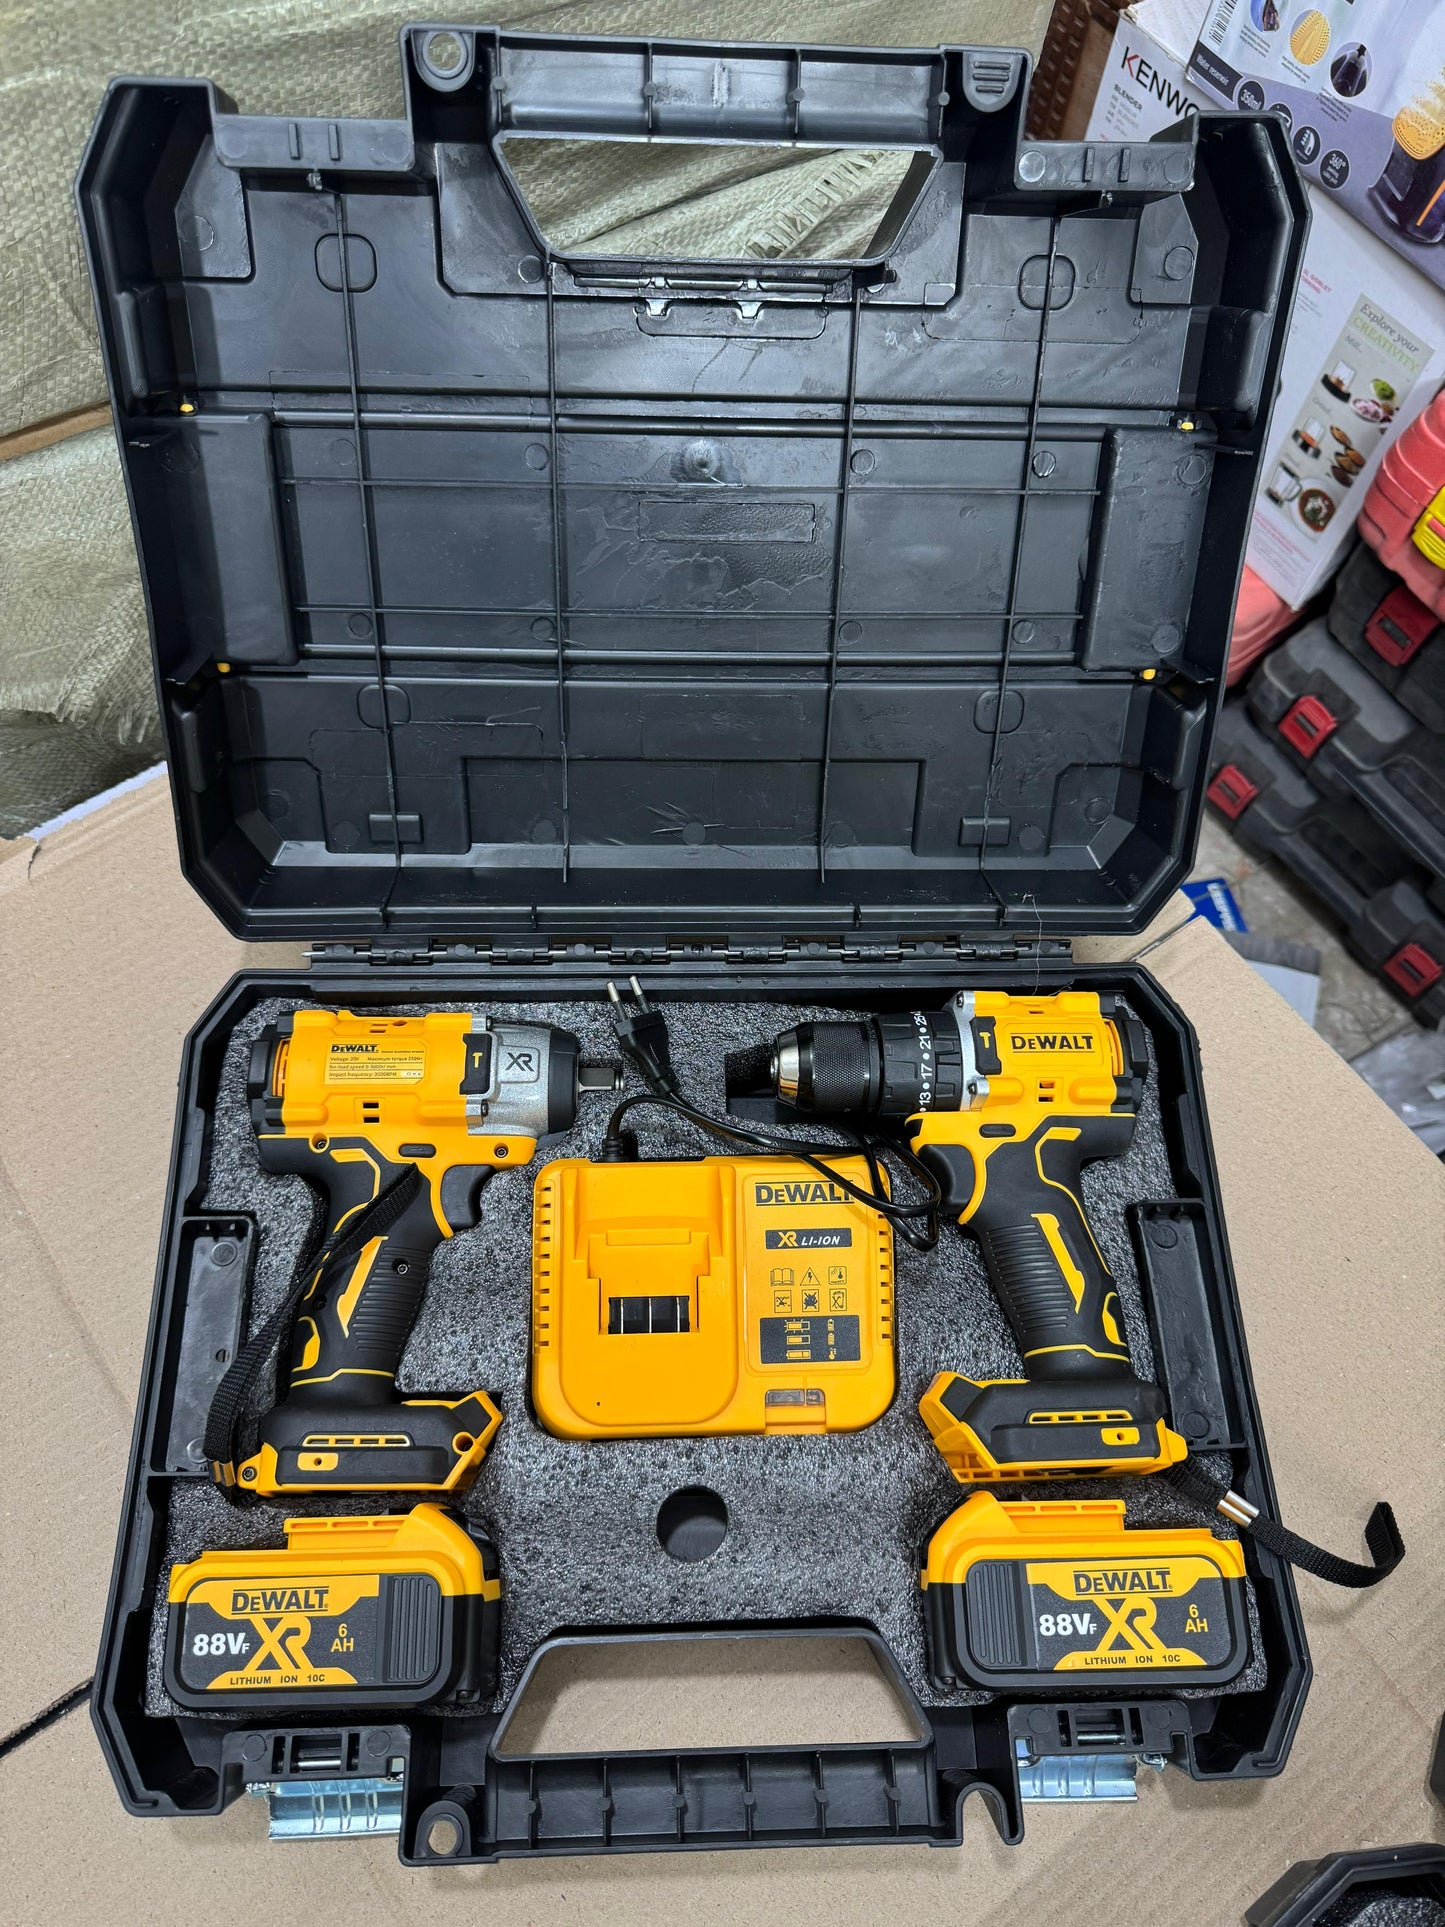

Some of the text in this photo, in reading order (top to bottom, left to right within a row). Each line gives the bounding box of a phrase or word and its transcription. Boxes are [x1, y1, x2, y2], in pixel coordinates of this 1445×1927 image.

[1196, 53, 1208, 70] Water
[1114, 84, 1142, 112] BLENDER
[1240, 89, 1262, 110] 350ml
[1360, 304, 1420, 354] Explore your
[1352, 315, 1418, 372] CREATIVITY
[332, 1044, 377, 1053] DEWALT
[1011, 1036, 1094, 1050] DEWALT
[505, 1052, 534, 1072] XR
[914, 1016, 932, 1106] 13 17 21 25
[778, 1230, 840, 1248] XR LI-ION
[1074, 1570, 1170, 1593] DEWALT
[232, 1590, 328, 1612] DEWALT
[1188, 1604, 1198, 1618] 6
[338, 1624, 348, 1638] 6
[1096, 1597, 1166, 1652] XR
[1184, 1618, 1208, 1634] AH
[244, 1615, 315, 1673] XR
[330, 1638, 354, 1653] AH
[1084, 1654, 1181, 1666] LITHIUM ION 10C
[230, 1674, 326, 1686] LITHIUM ION 10C
